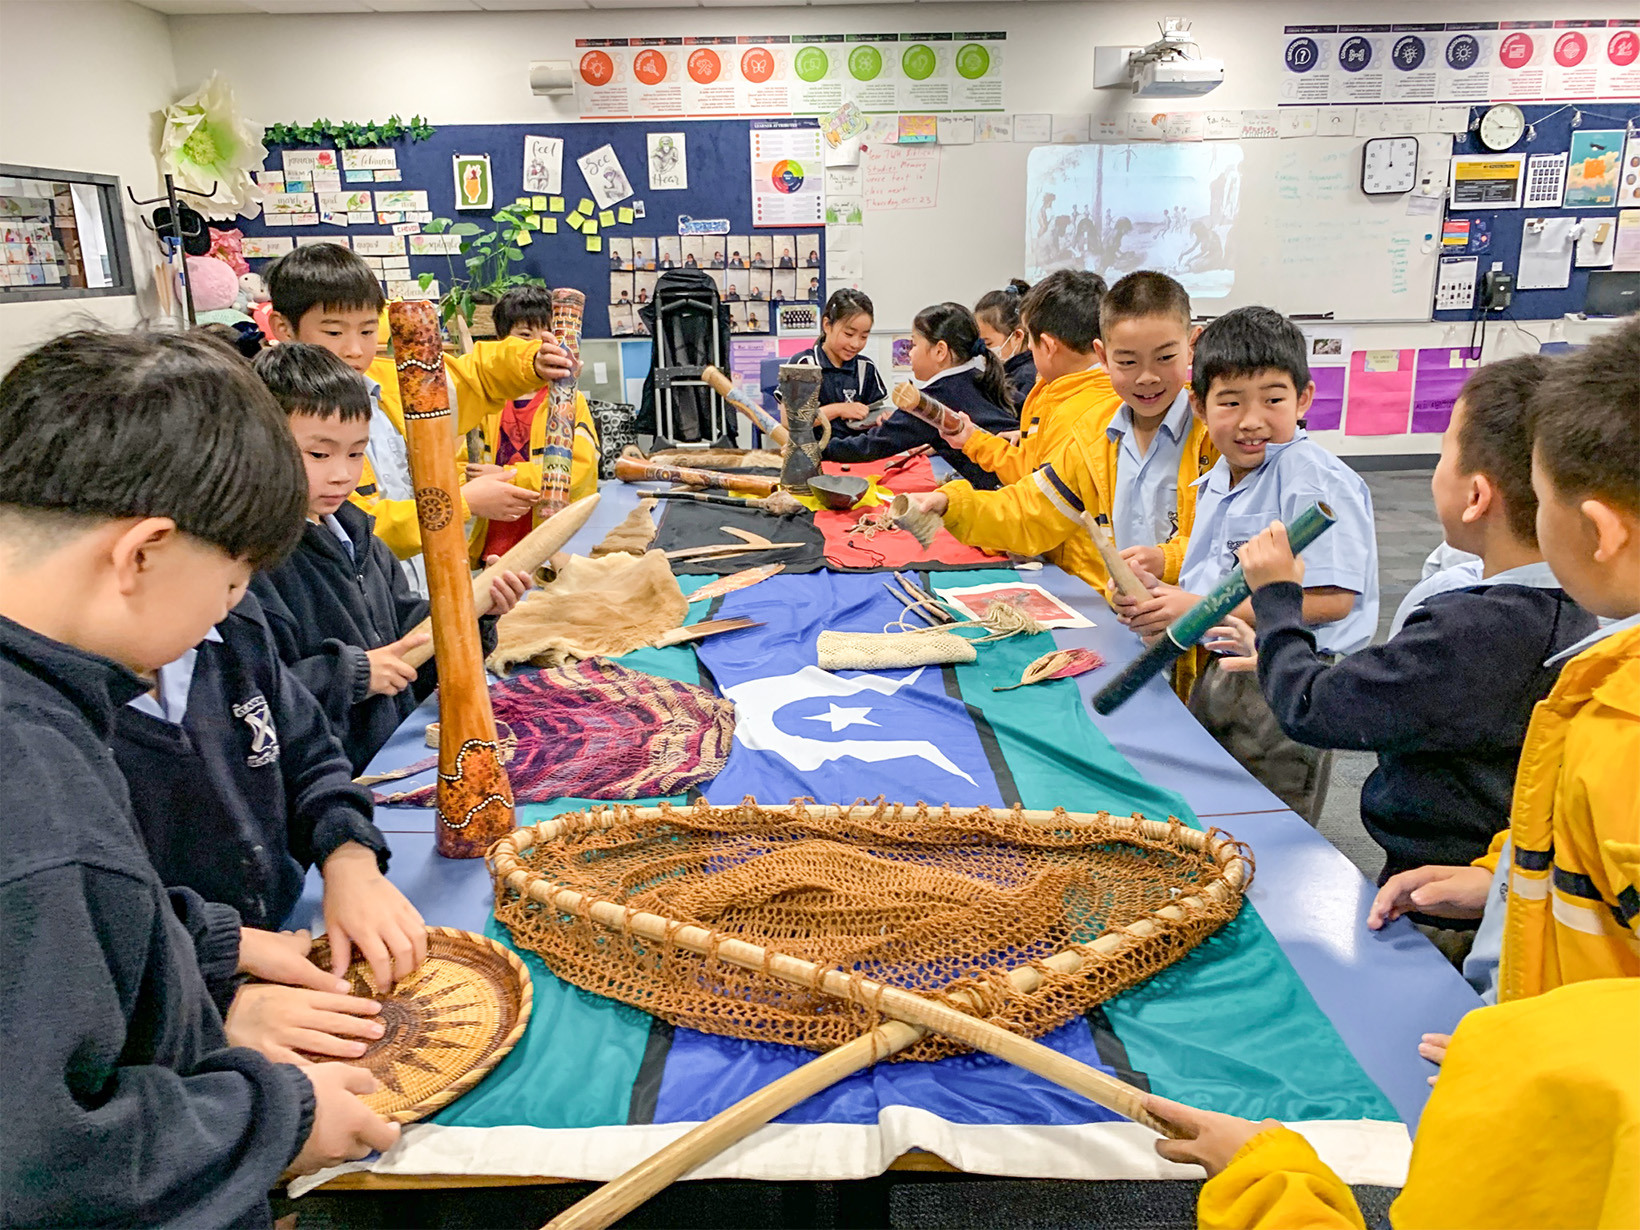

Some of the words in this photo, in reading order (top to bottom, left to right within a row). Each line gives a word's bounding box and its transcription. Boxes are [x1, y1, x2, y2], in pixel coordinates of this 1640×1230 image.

[584, 154, 611, 176] See
[653, 172, 681, 186] Hear
[919, 196, 932, 204] 23
